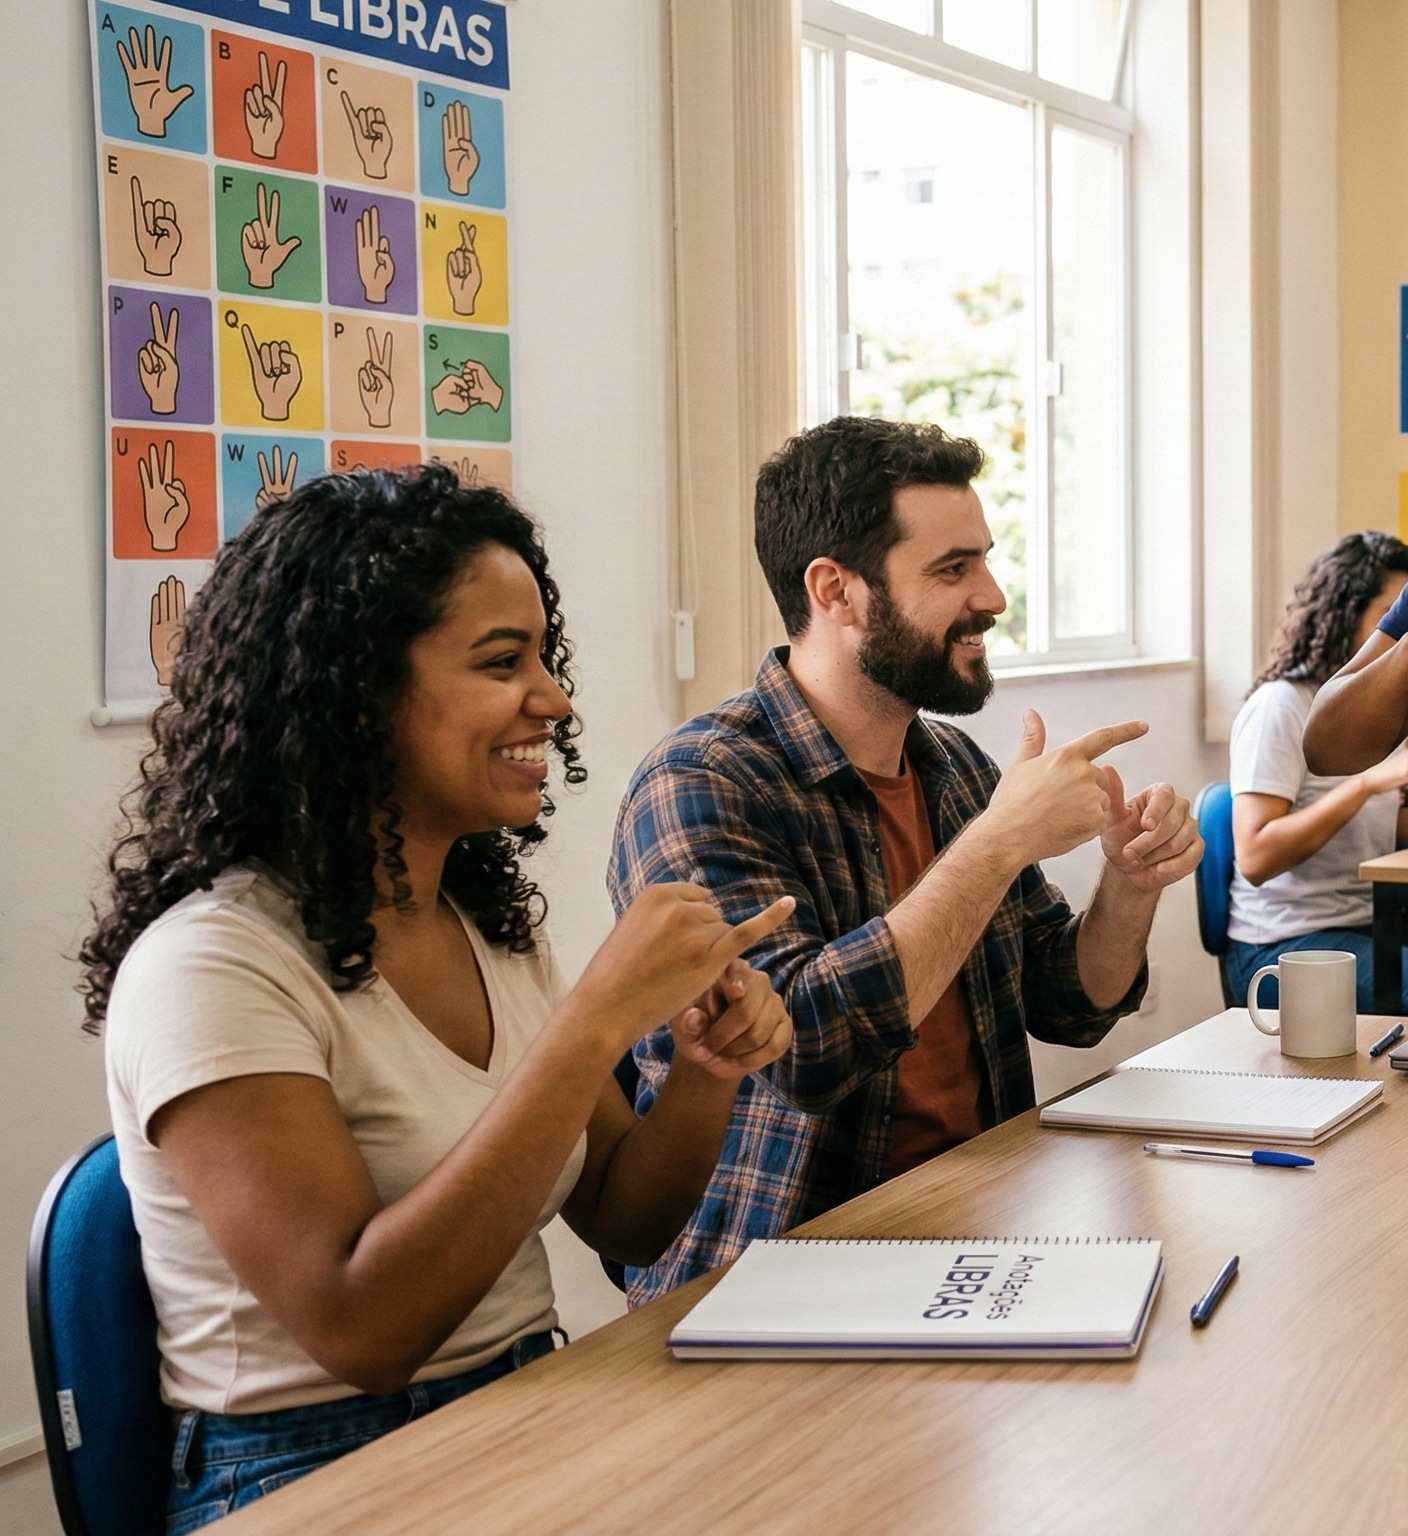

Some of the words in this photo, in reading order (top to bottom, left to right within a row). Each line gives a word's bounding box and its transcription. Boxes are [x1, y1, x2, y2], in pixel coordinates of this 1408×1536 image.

[101, 13, 116, 34] A
[218, 41, 231, 60] B
[326, 67, 338, 86] C
[424, 91, 435, 108] D
[107, 154, 119, 175] E
[222, 176, 234, 194] F
[330, 195, 348, 215] W
[425, 212, 437, 230] N
[113, 296, 124, 315] P
[224, 309, 239, 329] Q
[334, 322, 345, 339] P
[428, 333, 439, 351] S
[116, 437, 129, 457] U
[226, 443, 245, 462] W
[337, 449, 347, 467] S
[922, 1254, 999, 1320] LIBRAS
